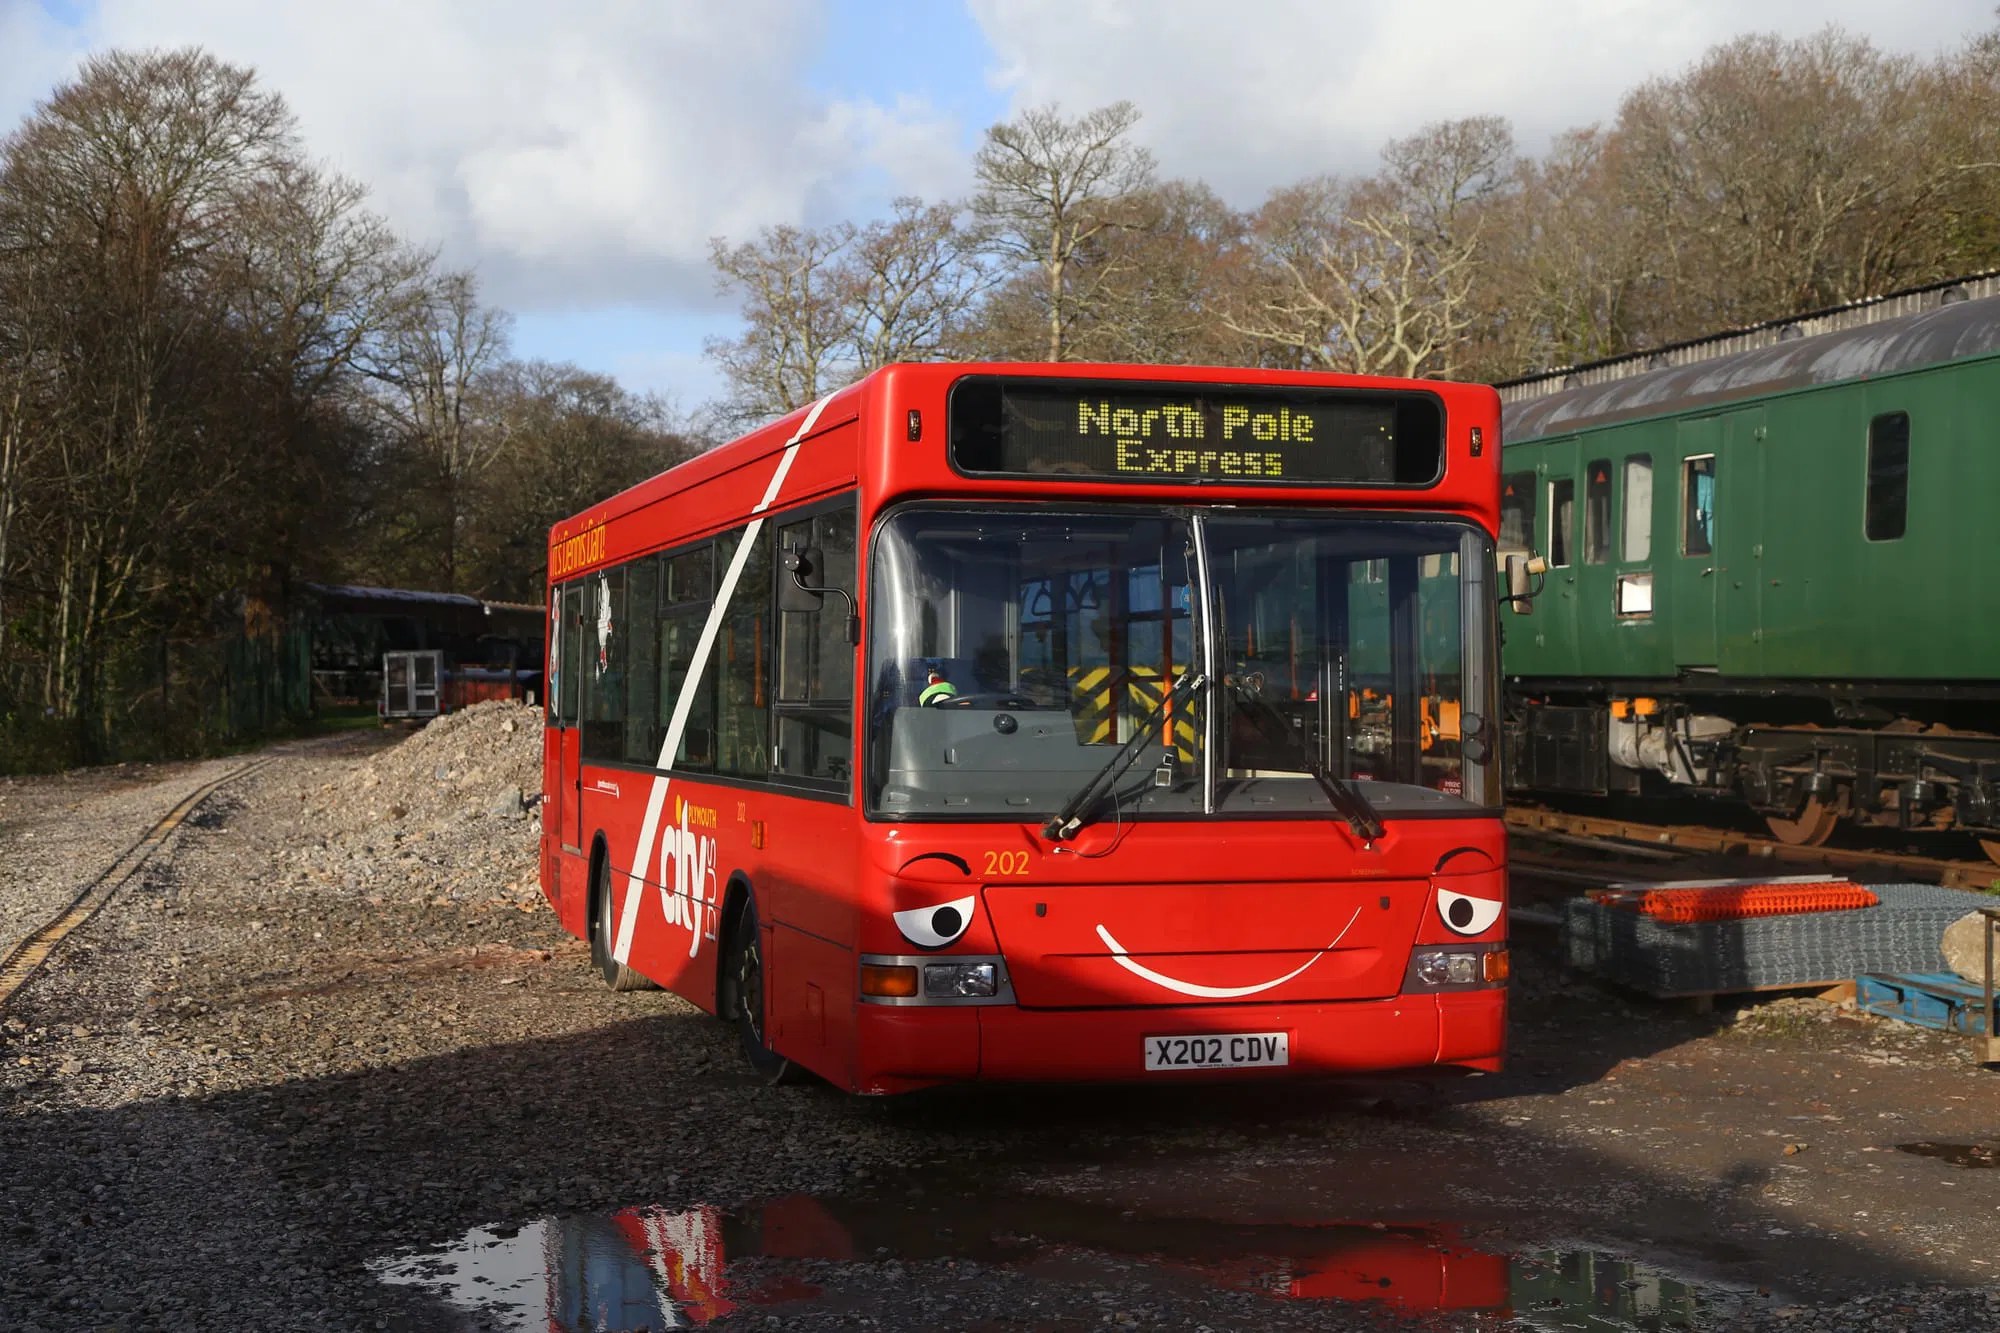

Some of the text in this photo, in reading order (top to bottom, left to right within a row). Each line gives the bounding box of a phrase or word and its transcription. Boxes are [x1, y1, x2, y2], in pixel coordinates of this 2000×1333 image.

[1079, 401, 1313, 441] North Pole
[1116, 439, 1282, 475] Express
[688, 804, 717, 829] PLYMOUTH
[737, 801, 746, 822] 202
[660, 795, 707, 958] city
[984, 851, 1030, 875] 202
[705, 838, 717, 942] bus
[1156, 1037, 1277, 1065] X202 CDV
